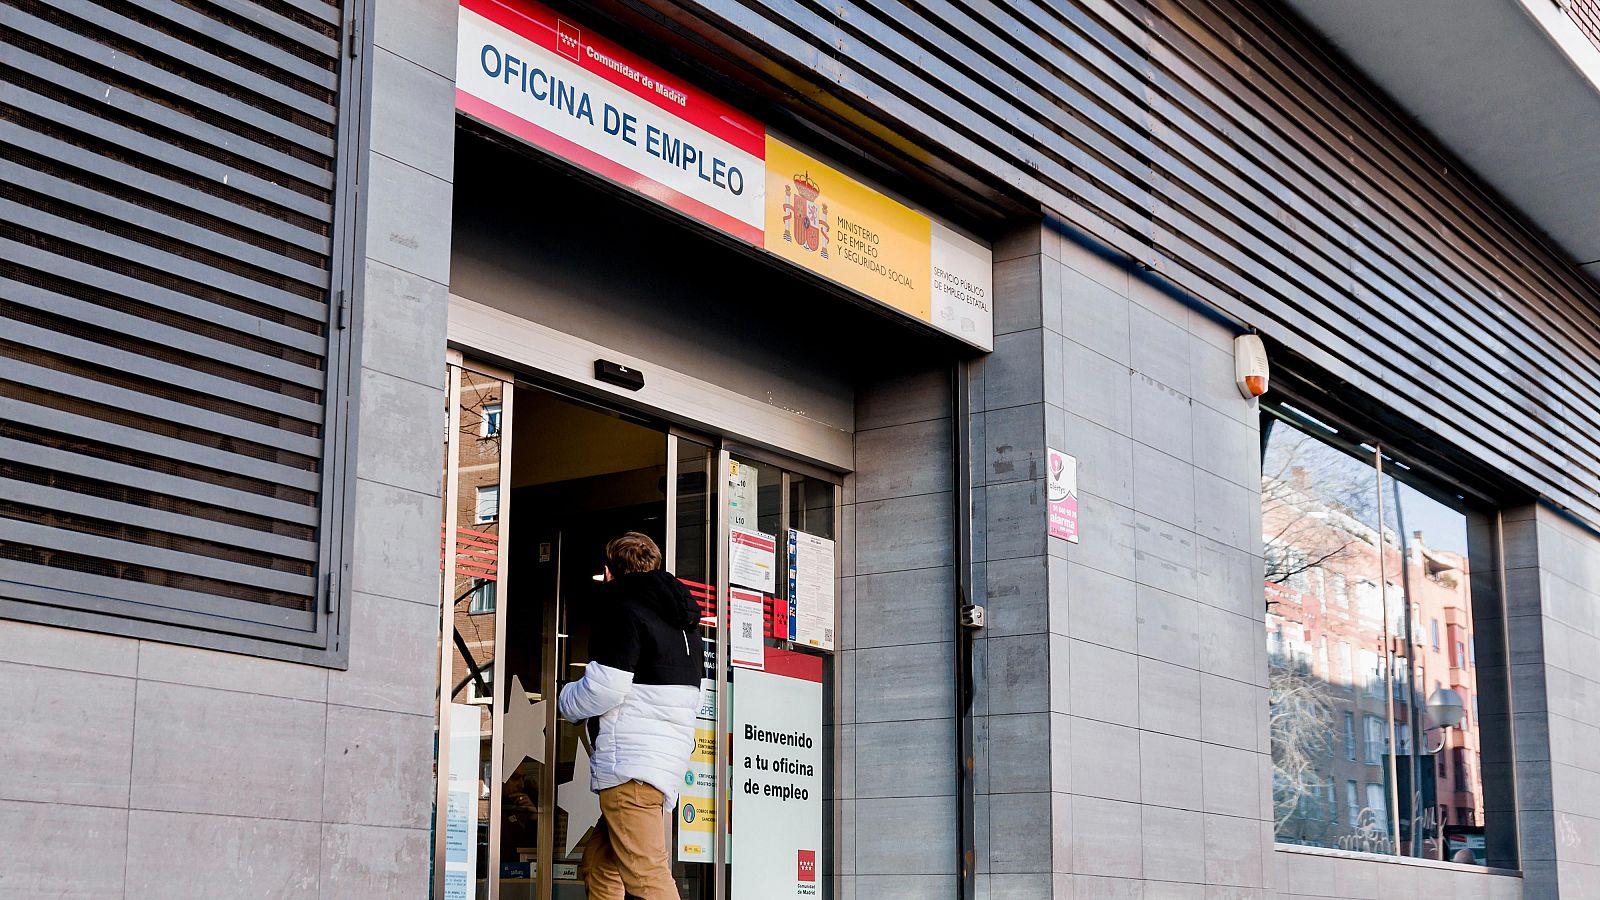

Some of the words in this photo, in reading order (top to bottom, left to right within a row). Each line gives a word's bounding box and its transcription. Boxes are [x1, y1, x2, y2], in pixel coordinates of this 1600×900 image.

[586, 46, 640, 82] Comunidad
[641, 76, 653, 89] de
[655, 82, 686, 107] Madrid
[480, 44, 594, 126] OFICINA
[603, 103, 637, 146] DE
[646, 123, 744, 196] EMPLEO
[837, 216, 879, 245] MINISTERIO
[837, 231, 848, 244] DE
[849, 238, 878, 258] EMPLEO
[837, 245, 843, 256] Y
[844, 248, 886, 277] SEGURIDAD
[888, 269, 914, 290] SOCIAL
[934, 266, 960, 286] SERVICIO
[960, 277, 985, 298] PÚBLICO
[934, 280, 943, 290] DE
[943, 284, 965, 302] EMPLEO
[966, 292, 988, 312] ESTATAL
[735, 516, 745, 525] L10
[1050, 512, 1075, 530] alarma
[744, 723, 813, 749] Bienvenido
[744, 756, 752, 769] a
[755, 754, 769, 771] tu
[772, 757, 814, 777] oficina
[744, 778, 760, 795] de
[763, 783, 809, 802] empleo
